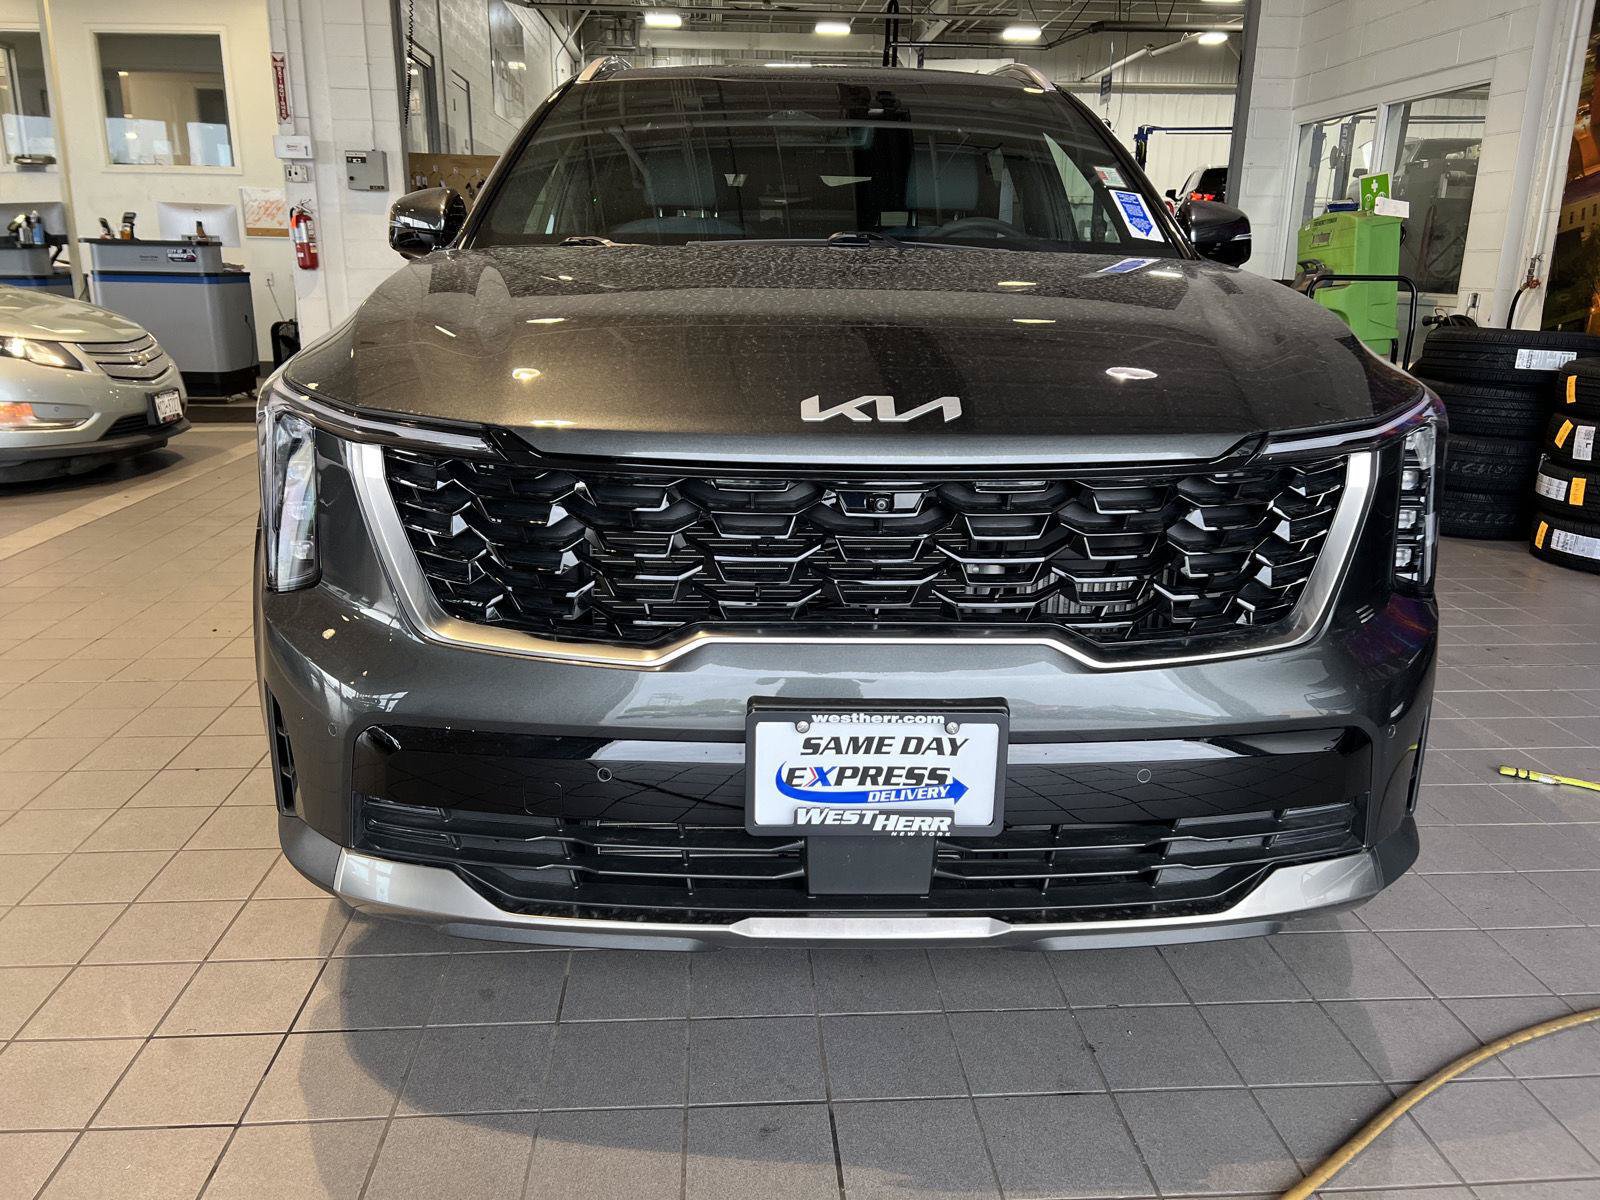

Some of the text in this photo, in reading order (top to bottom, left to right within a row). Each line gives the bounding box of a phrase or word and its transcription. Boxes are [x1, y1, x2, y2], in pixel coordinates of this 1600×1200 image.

[811, 713, 945, 725] westherr.com
[800, 736, 969, 757] SAME DAY
[785, 766, 951, 787] EXPRESS
[867, 785, 951, 803] DELIVERY
